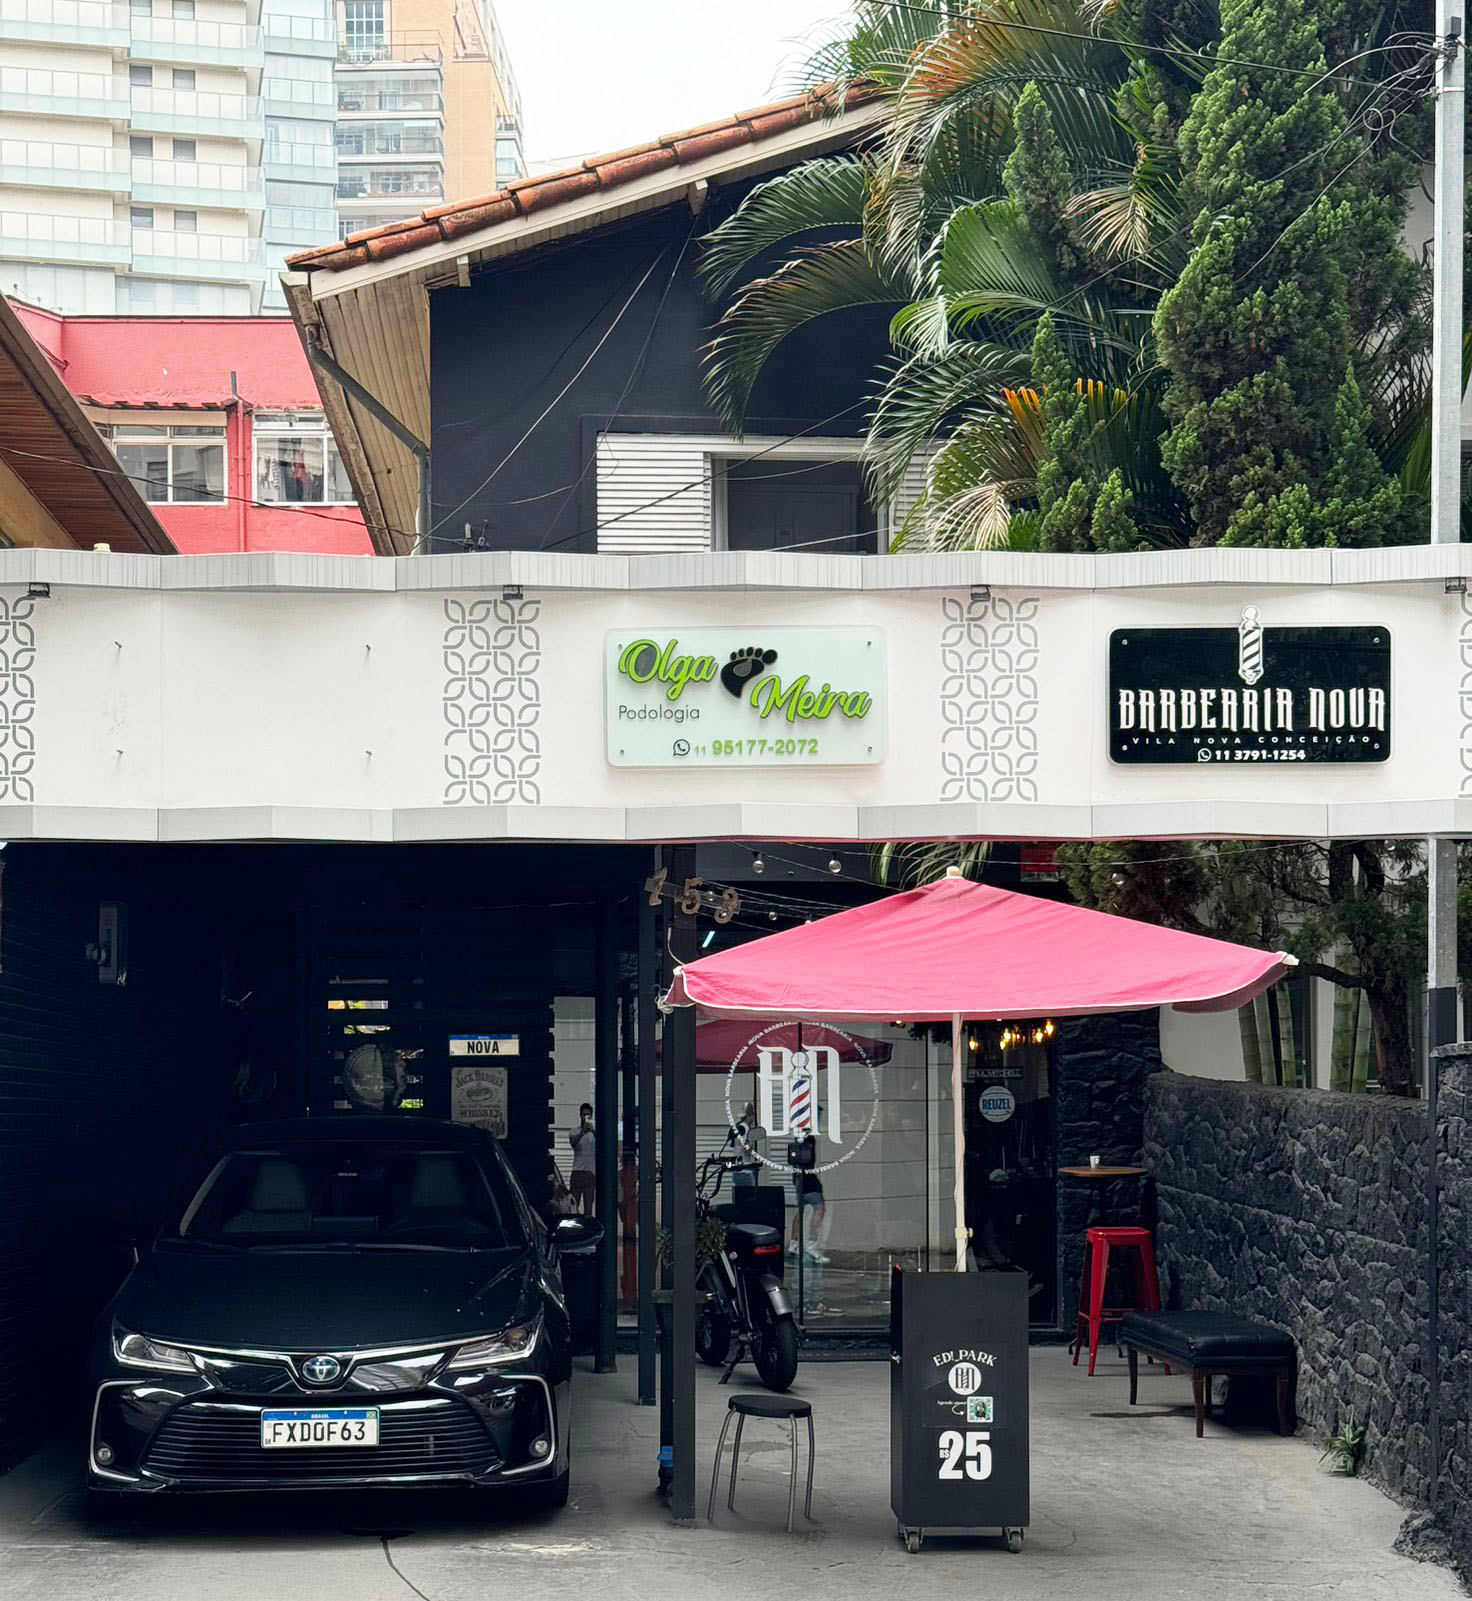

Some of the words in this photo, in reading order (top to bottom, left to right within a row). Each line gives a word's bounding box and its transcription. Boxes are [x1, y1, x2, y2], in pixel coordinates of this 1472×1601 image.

[618, 639, 719, 701] Olga
[751, 674, 873, 723] Meira
[618, 704, 701, 724] Podologia
[1119, 688, 1294, 733] BARBEARIA
[1308, 687, 1385, 732] NOVA
[694, 745, 706, 756] 11
[711, 738, 819, 756] 95177-2072
[1132, 737, 1176, 745] VILA
[1193, 737, 1242, 745] NOVA
[1258, 734, 1370, 745] CONCEIÇÃO
[1215, 750, 1230, 761] 11
[1233, 749, 1306, 761] 3791-1254
[467, 1040, 500, 1054] NOVA
[982, 1098, 1011, 1111] REUZEL
[938, 1430, 993, 1481] 25
